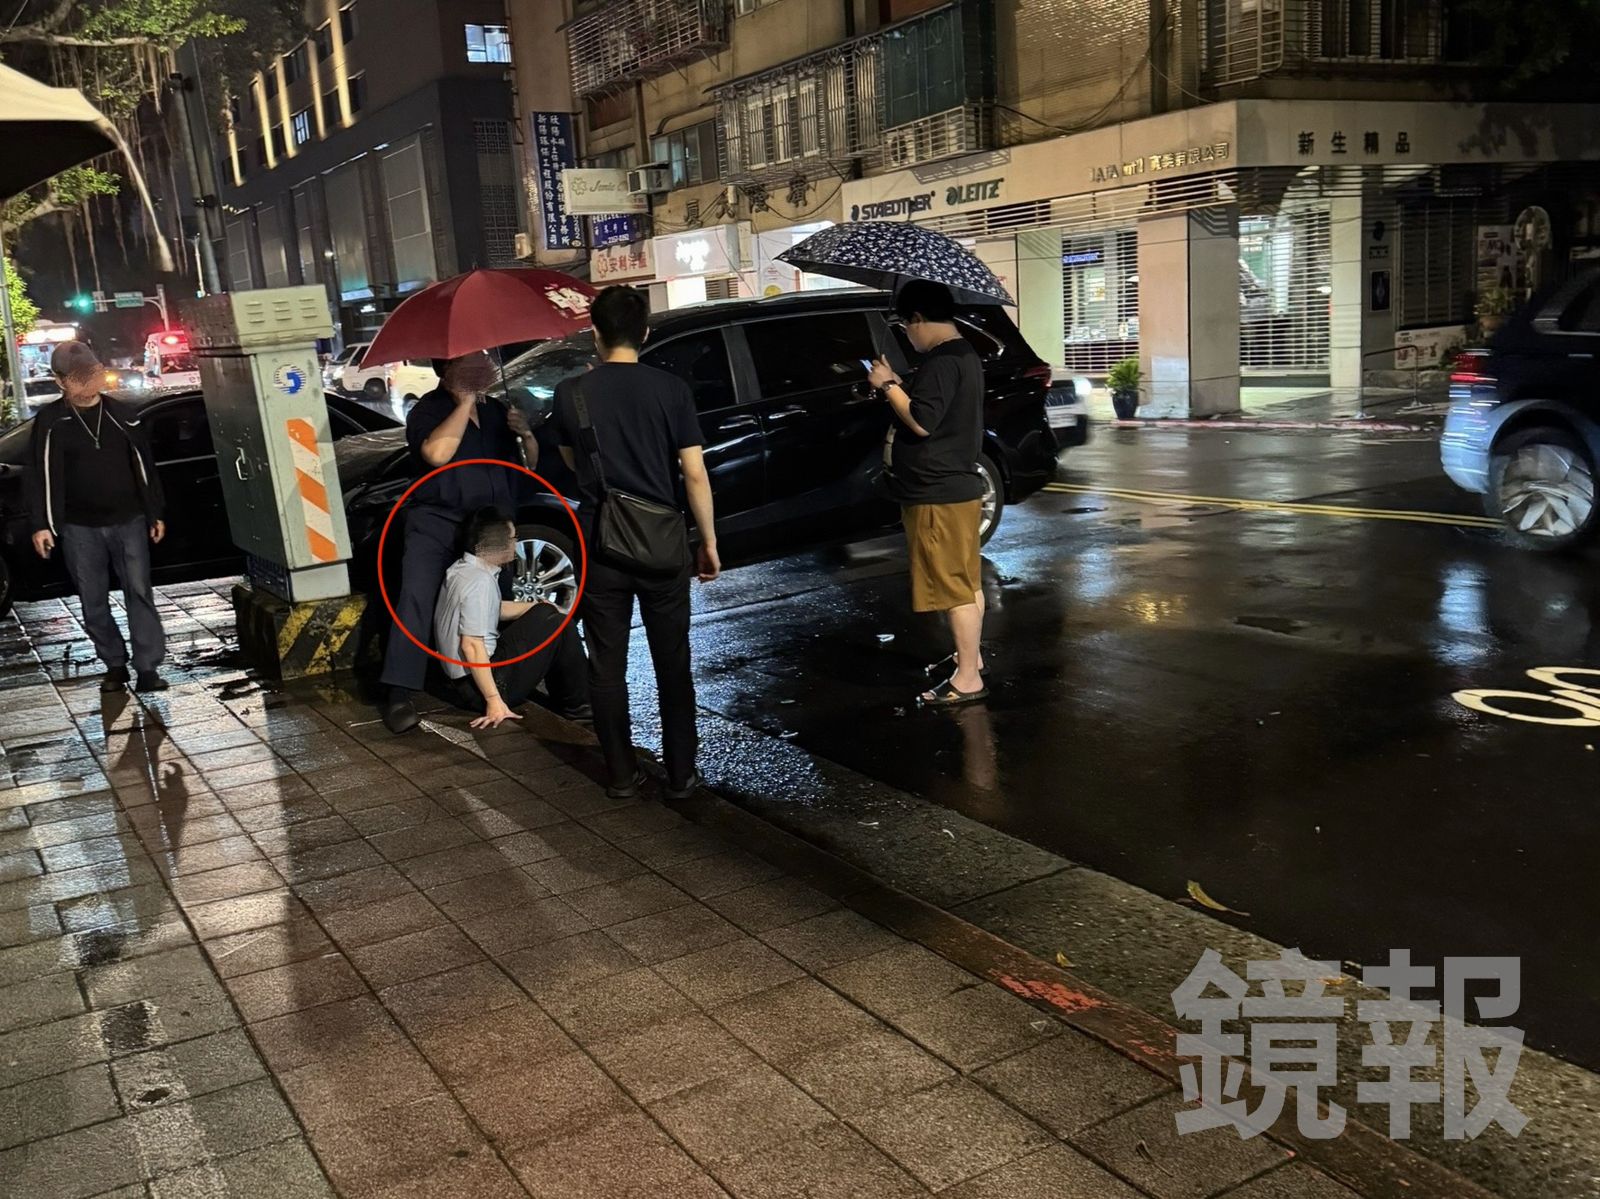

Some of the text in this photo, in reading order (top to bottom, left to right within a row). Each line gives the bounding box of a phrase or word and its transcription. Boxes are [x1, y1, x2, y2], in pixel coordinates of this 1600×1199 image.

[1298, 131, 1410, 155] 新生精品
[957, 178, 1000, 204] LEITZ
